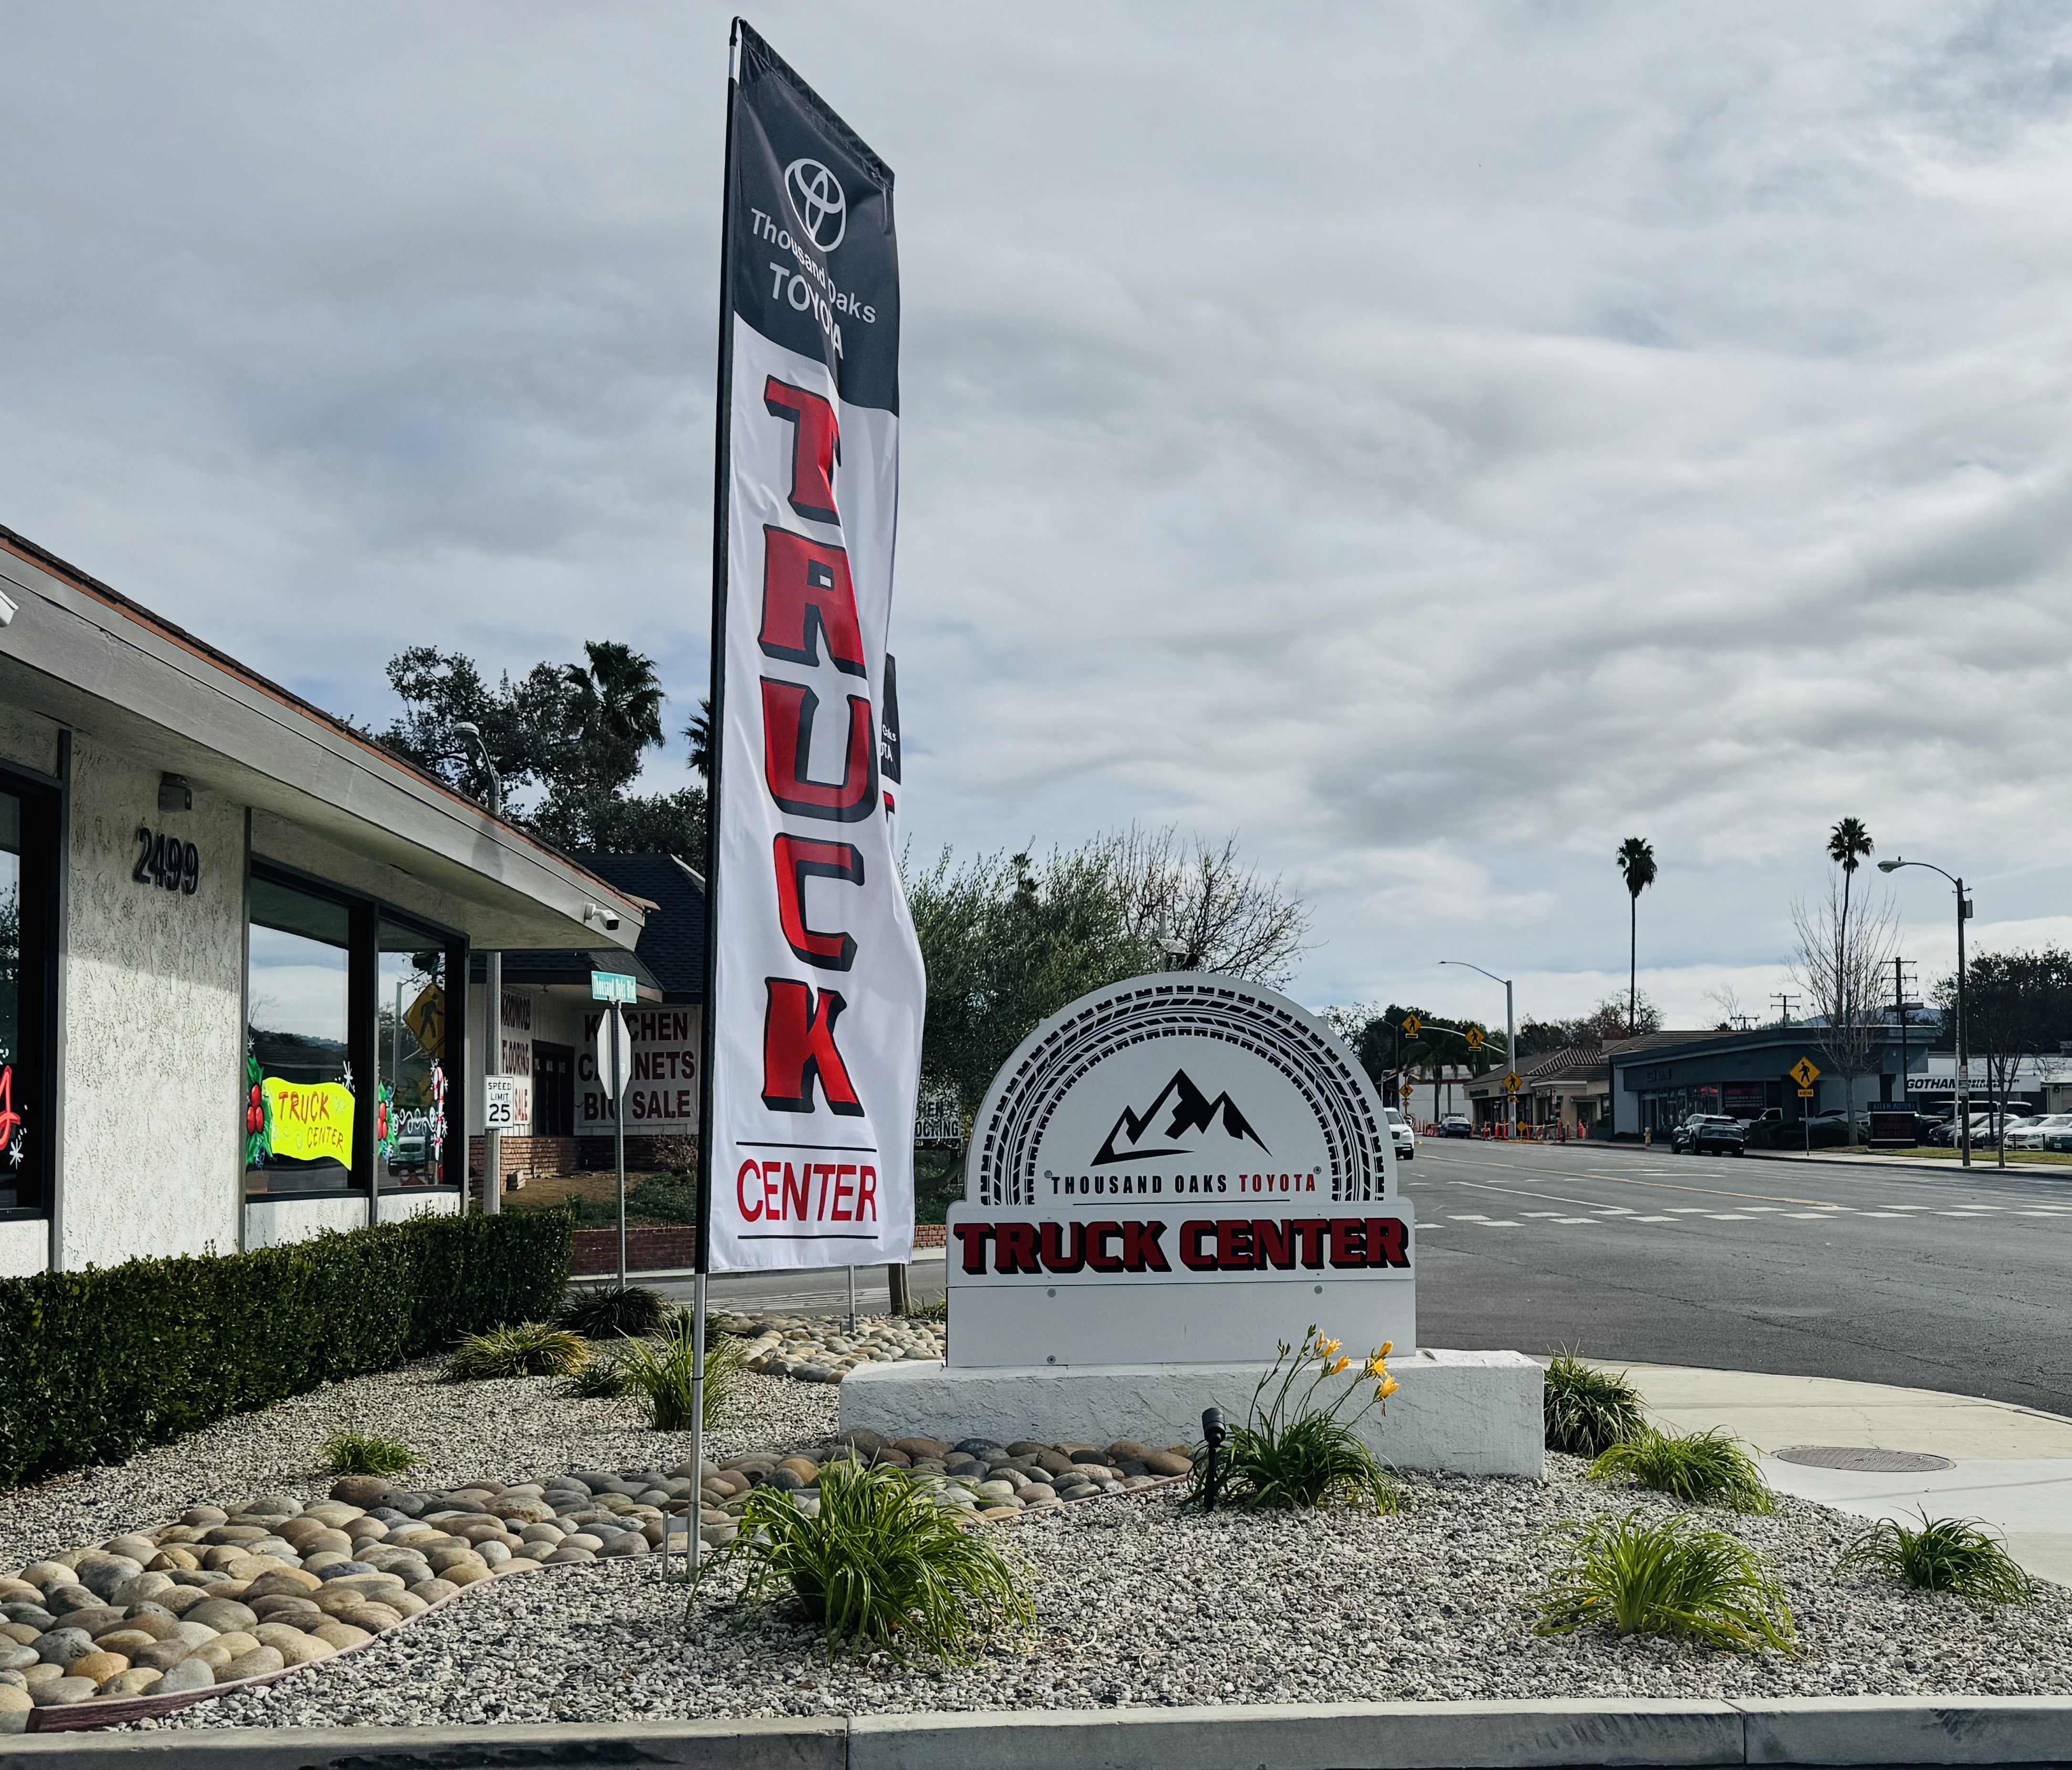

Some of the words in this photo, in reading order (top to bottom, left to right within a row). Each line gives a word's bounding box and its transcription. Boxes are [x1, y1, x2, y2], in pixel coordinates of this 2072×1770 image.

[751, 208, 826, 290] Thousand
[828, 278, 876, 323] Oaks
[770, 261, 844, 360] TOYOTA
[758, 374, 879, 1117] TRUCK
[134, 827, 199, 895] 2499
[584, 1012, 688, 1042] KCHEN
[502, 1039, 529, 1076] FLOORING
[578, 1050, 695, 1082] CNETS
[488, 1082, 512, 1090] SPEED
[491, 1093, 509, 1102] LIMIT
[279, 1091, 330, 1124] TRUCK
[489, 1104, 511, 1122] 25
[632, 1090, 691, 1120] SALE
[307, 1126, 344, 1154] CENTER
[737, 1159, 877, 1222] CENTER
[1051, 1175, 1162, 1195] THOUSAND
[1175, 1175, 1227, 1194] OAKS
[1239, 1174, 1316, 1192] TOYOTA
[953, 1220, 1172, 1276] TRUCK
[1180, 1217, 1411, 1272] CENTER
